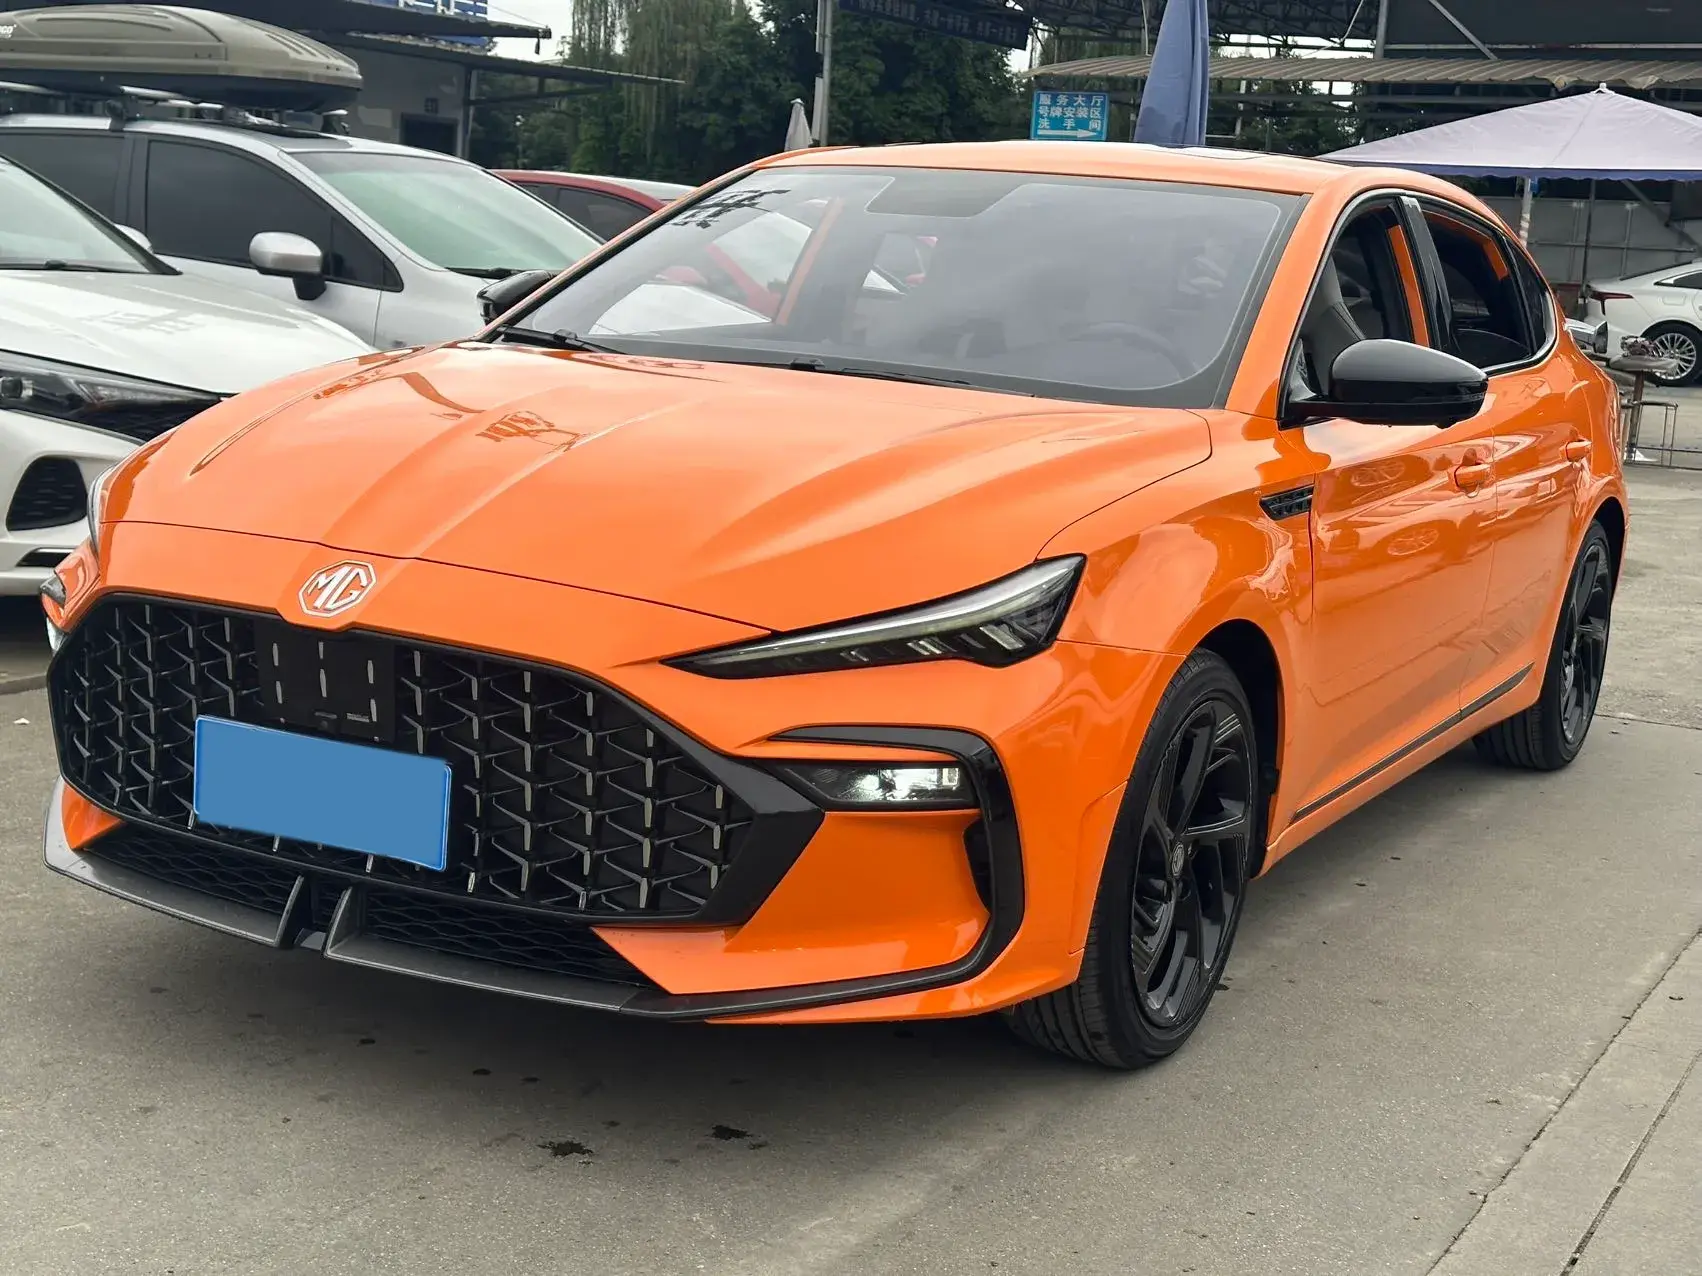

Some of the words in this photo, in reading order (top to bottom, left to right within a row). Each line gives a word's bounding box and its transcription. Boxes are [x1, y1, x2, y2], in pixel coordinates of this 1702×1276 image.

[1038, 118, 1101, 131] 洗手间
[307, 565, 369, 610] MG
